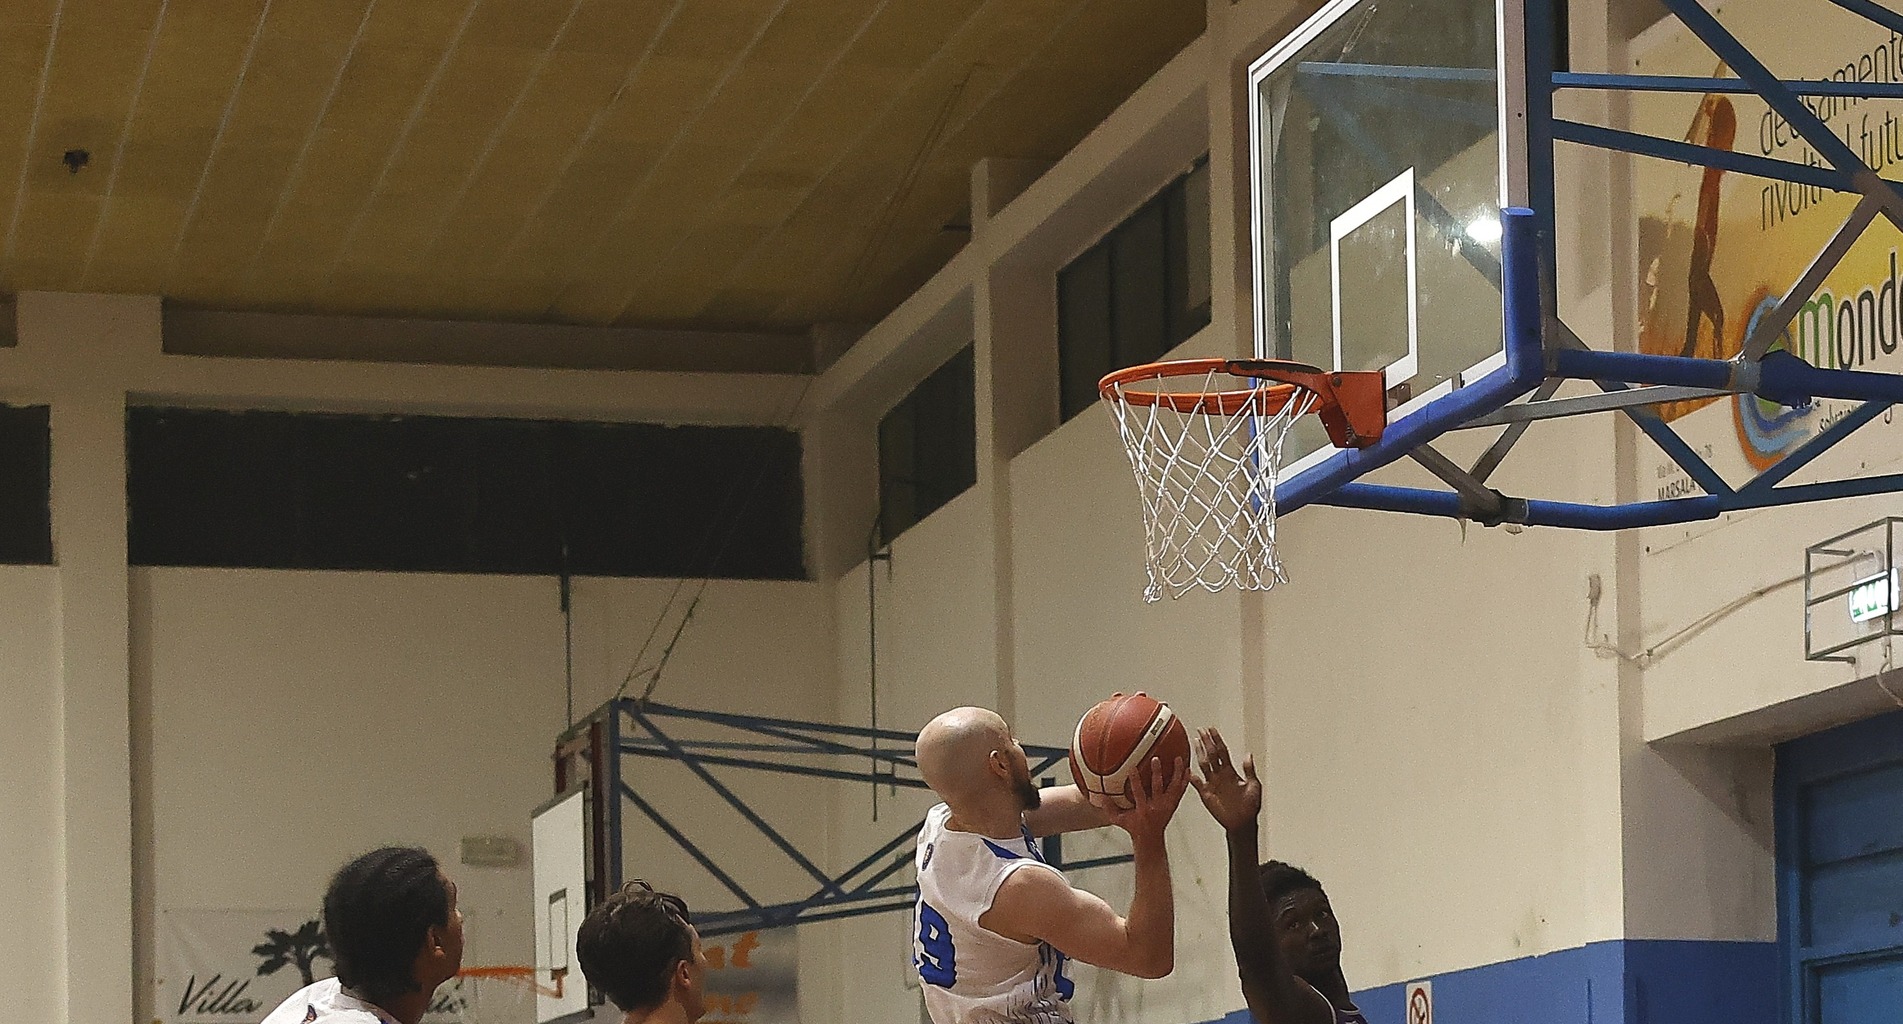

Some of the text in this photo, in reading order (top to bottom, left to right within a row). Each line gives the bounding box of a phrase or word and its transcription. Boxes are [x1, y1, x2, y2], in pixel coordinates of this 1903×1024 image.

[1760, 29, 1903, 156] desament
[1799, 251, 1903, 372] mond
[178, 973, 263, 1015] Villa
[911, 898, 958, 988] 9
